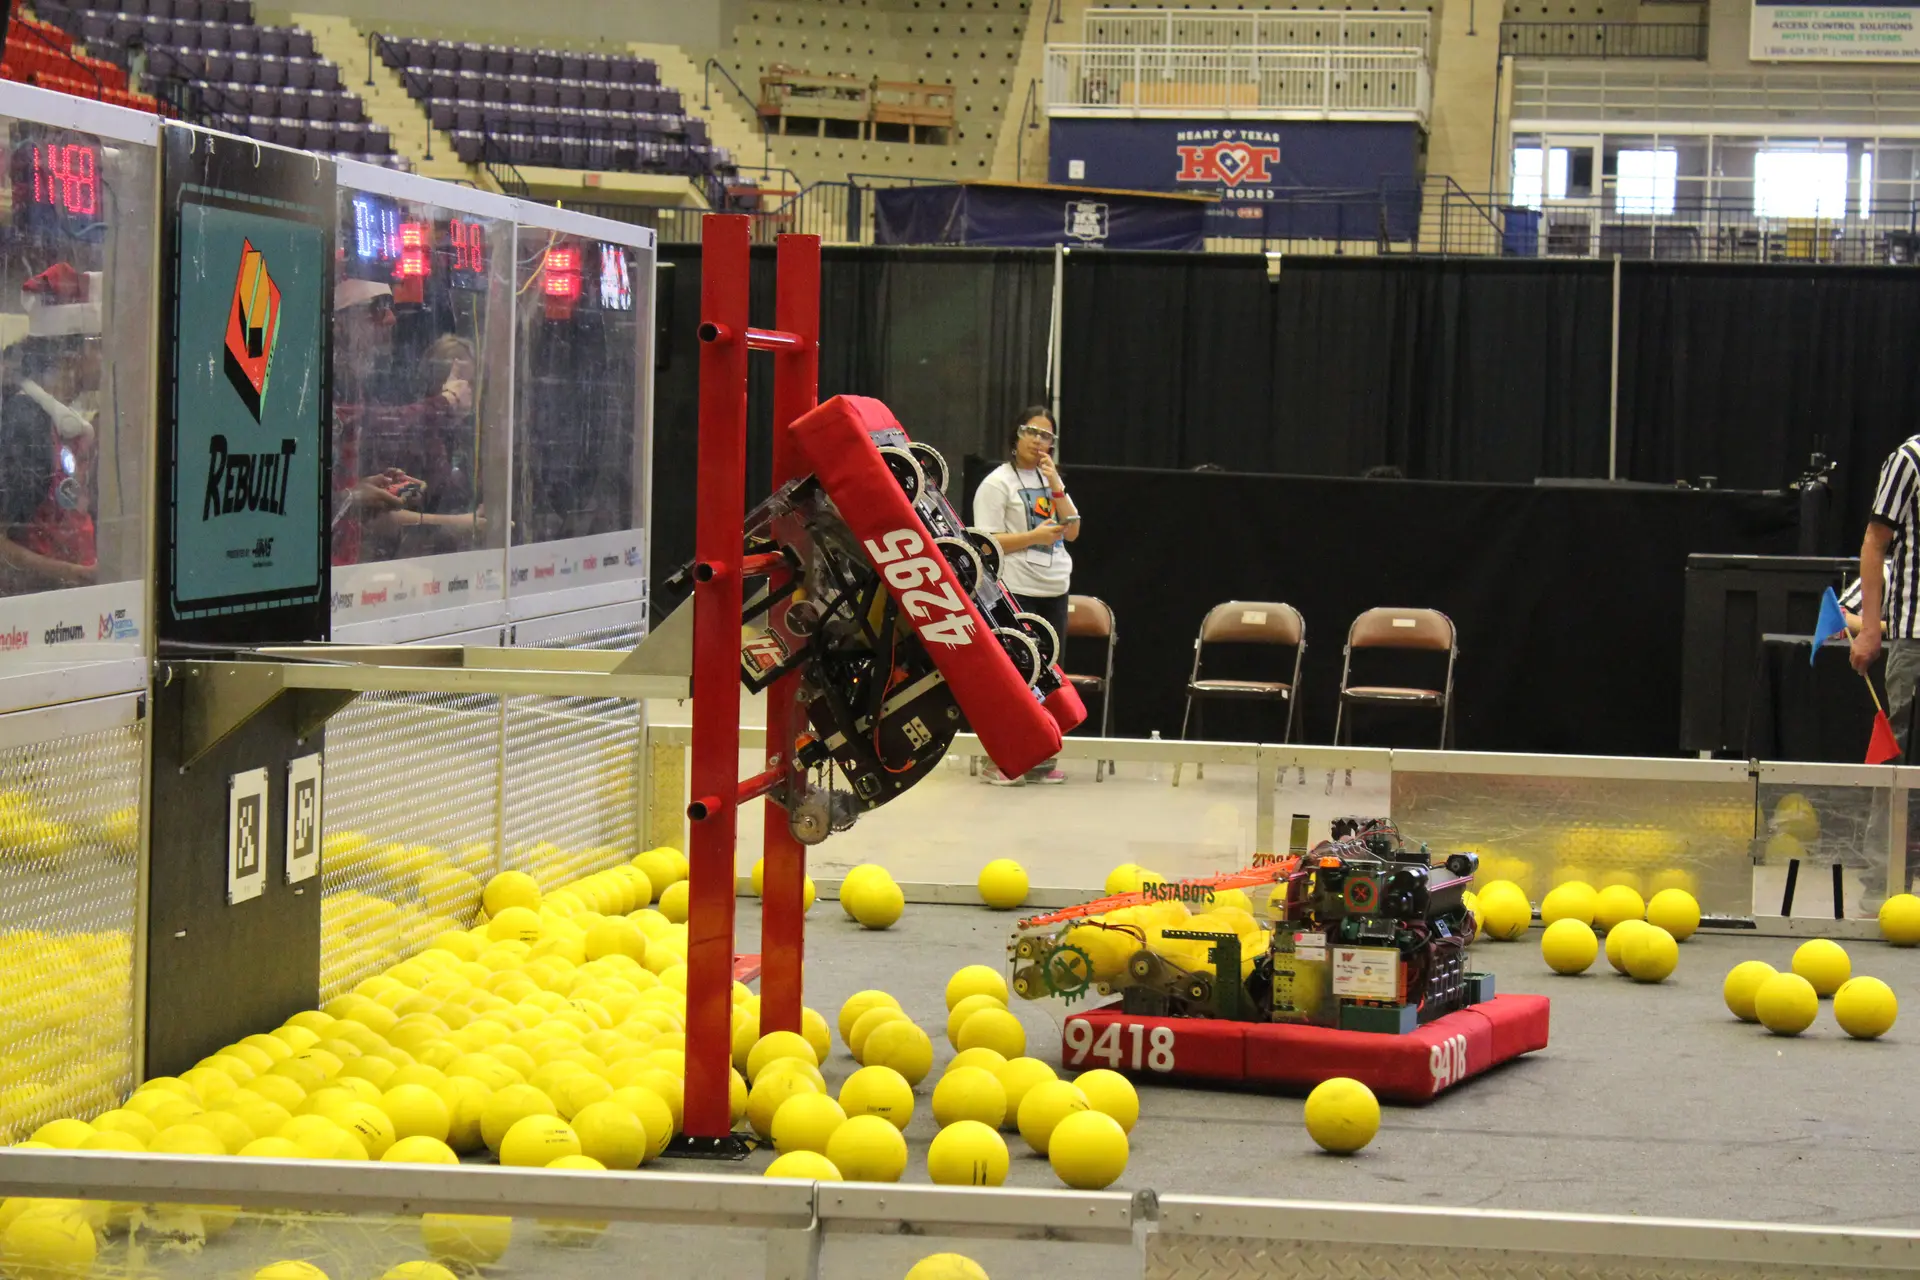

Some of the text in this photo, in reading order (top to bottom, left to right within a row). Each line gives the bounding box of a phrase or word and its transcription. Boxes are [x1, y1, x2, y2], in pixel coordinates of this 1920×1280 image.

[1822, 10, 1864, 19] CAMERA
[1867, 11, 1912, 20] SYSTEMS
[1772, 21, 1913, 31] ACCESS CONTROL SOLUTIONS
[1822, 33, 1855, 41] PHONE
[1858, 33, 1903, 42] SYSTEMS
[1177, 129, 1219, 141] HEART
[1240, 129, 1280, 143] TEXAS
[1226, 189, 1275, 200] RODEO
[202, 434, 297, 522] REBUILT
[863, 528, 977, 650] 4295
[1142, 881, 1216, 904] PASTABOTS
[1064, 1018, 1175, 1073] 9418
[1429, 1033, 1467, 1093] 9418
